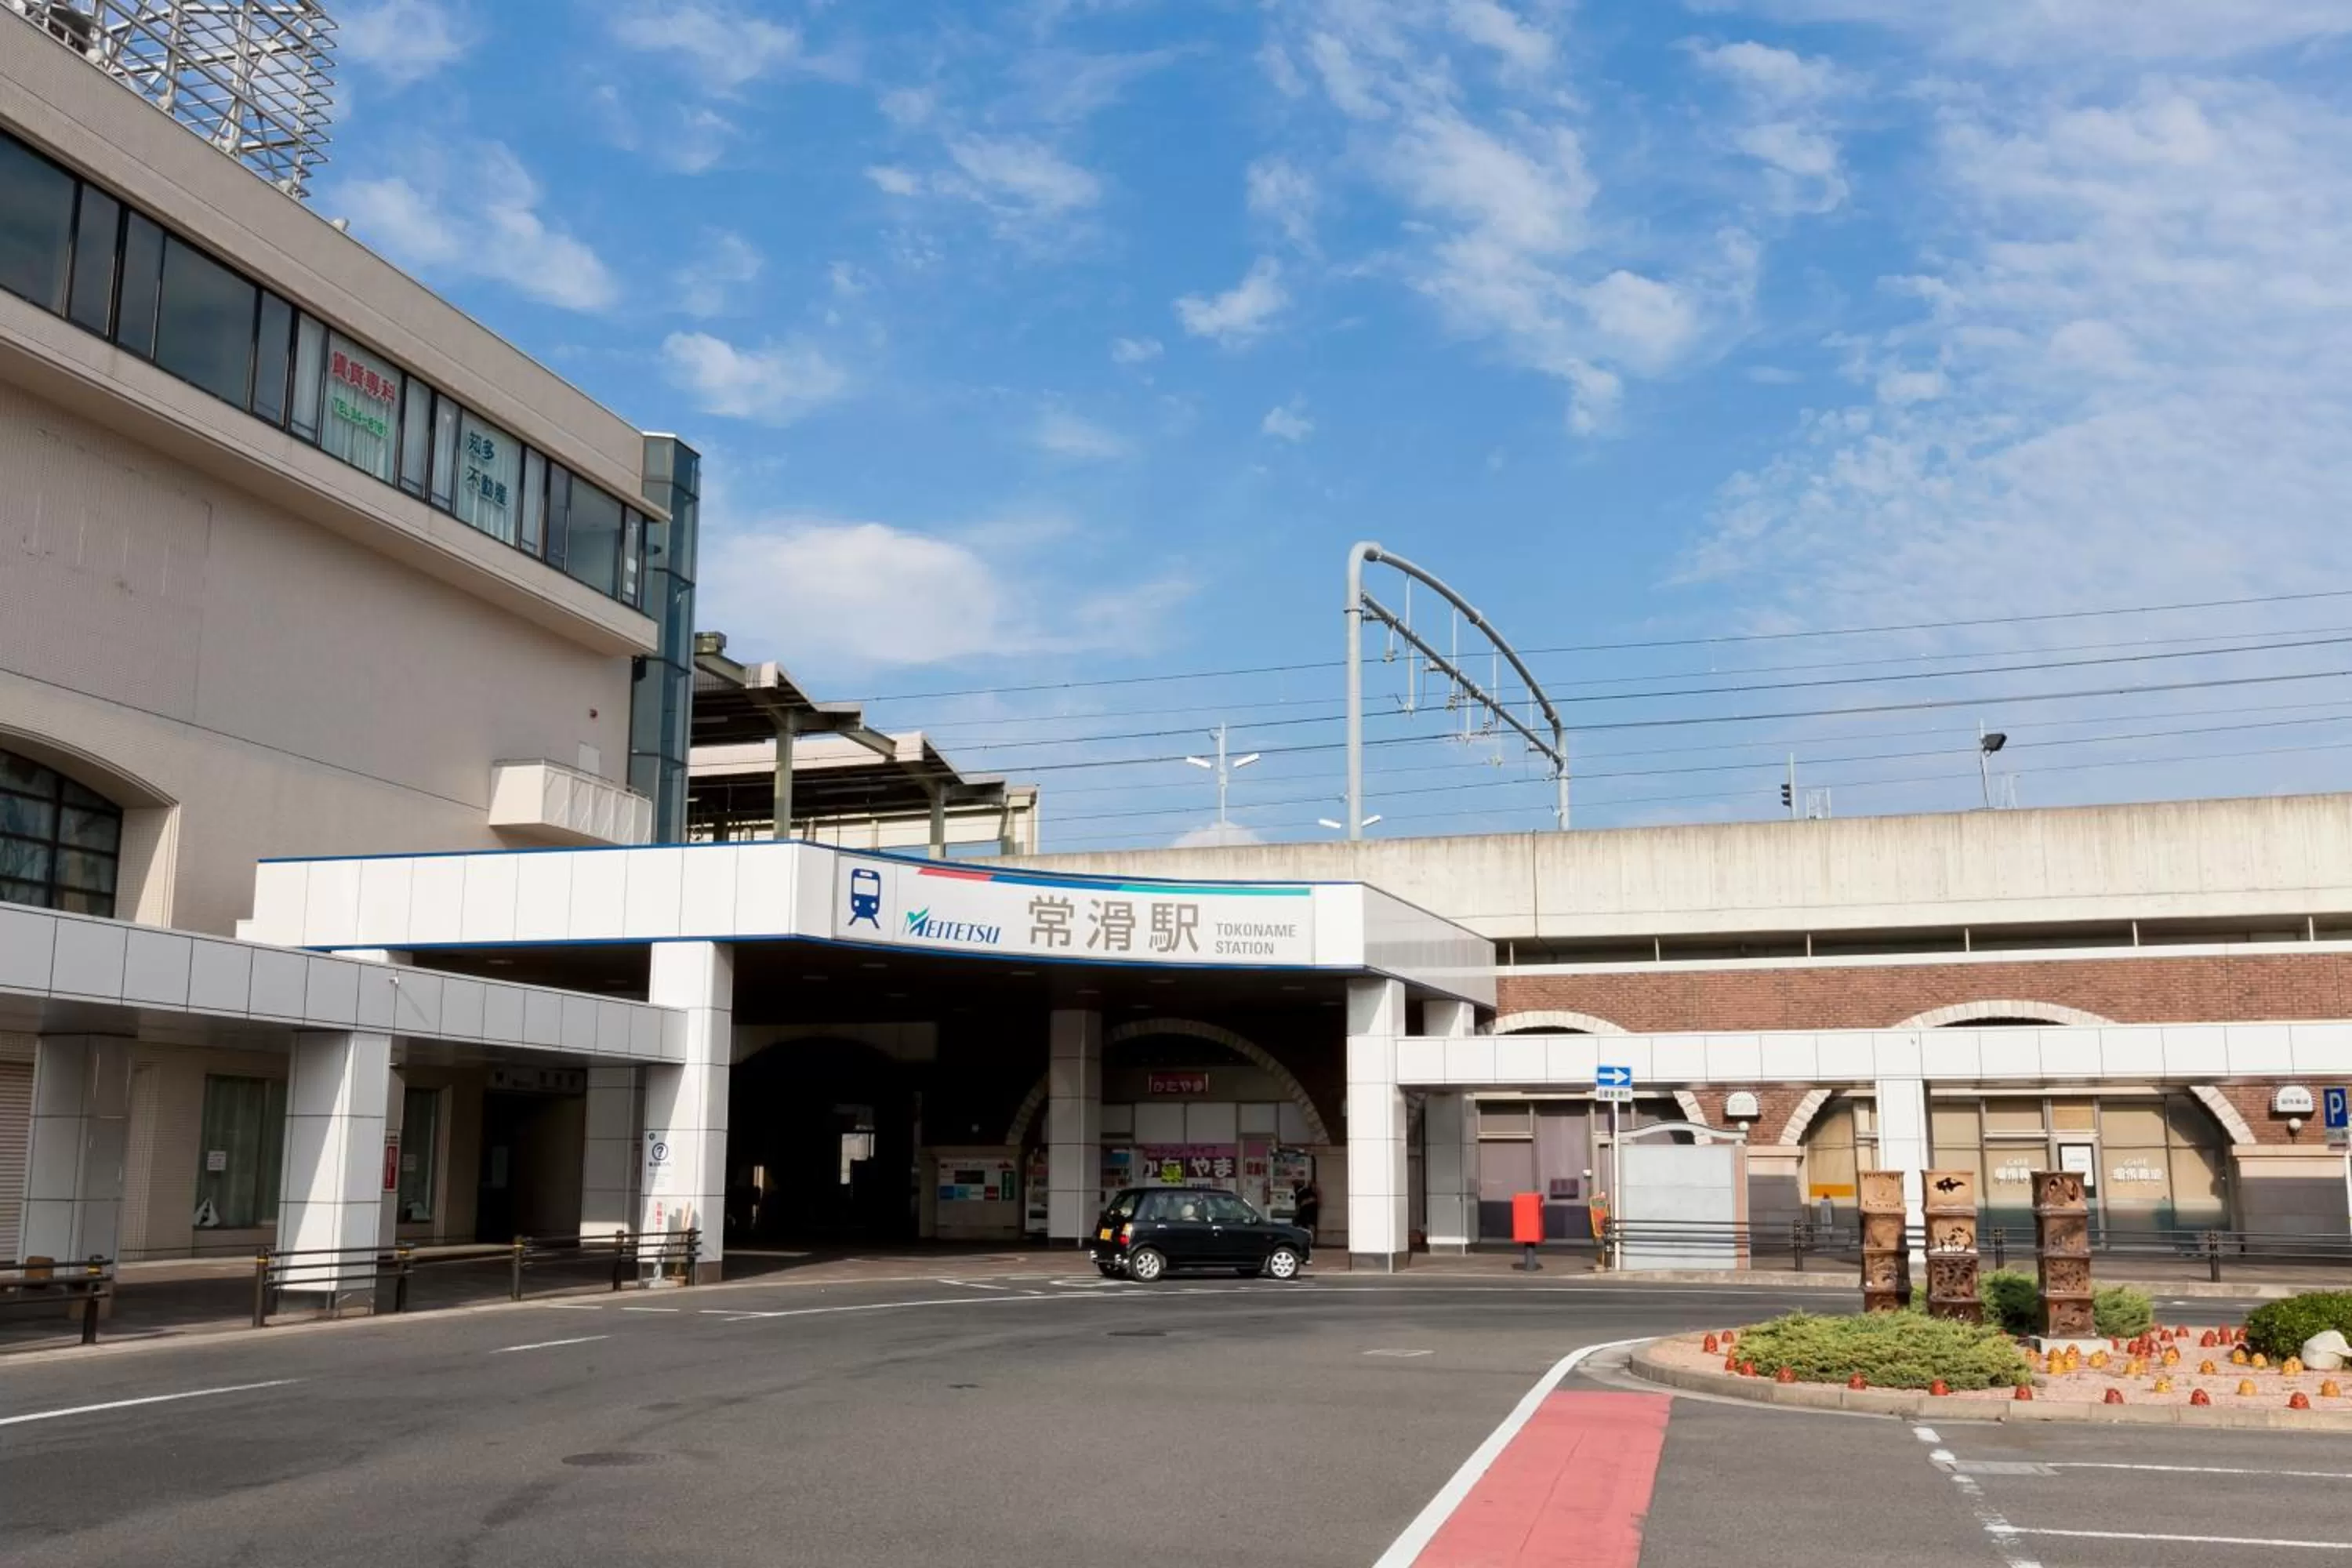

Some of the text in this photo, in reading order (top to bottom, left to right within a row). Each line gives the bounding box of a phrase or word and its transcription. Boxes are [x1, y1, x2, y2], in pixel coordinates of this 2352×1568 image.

[467, 430, 495, 460] 知多
[466, 465, 508, 506] 不動産
[902, 906, 1001, 944] MEITETSU
[1028, 895, 1200, 953] 常滑駅
[1216, 922, 1298, 938] TOKONAME
[1215, 940, 1275, 955] STATION
[2328, 1091, 2343, 1124] P
